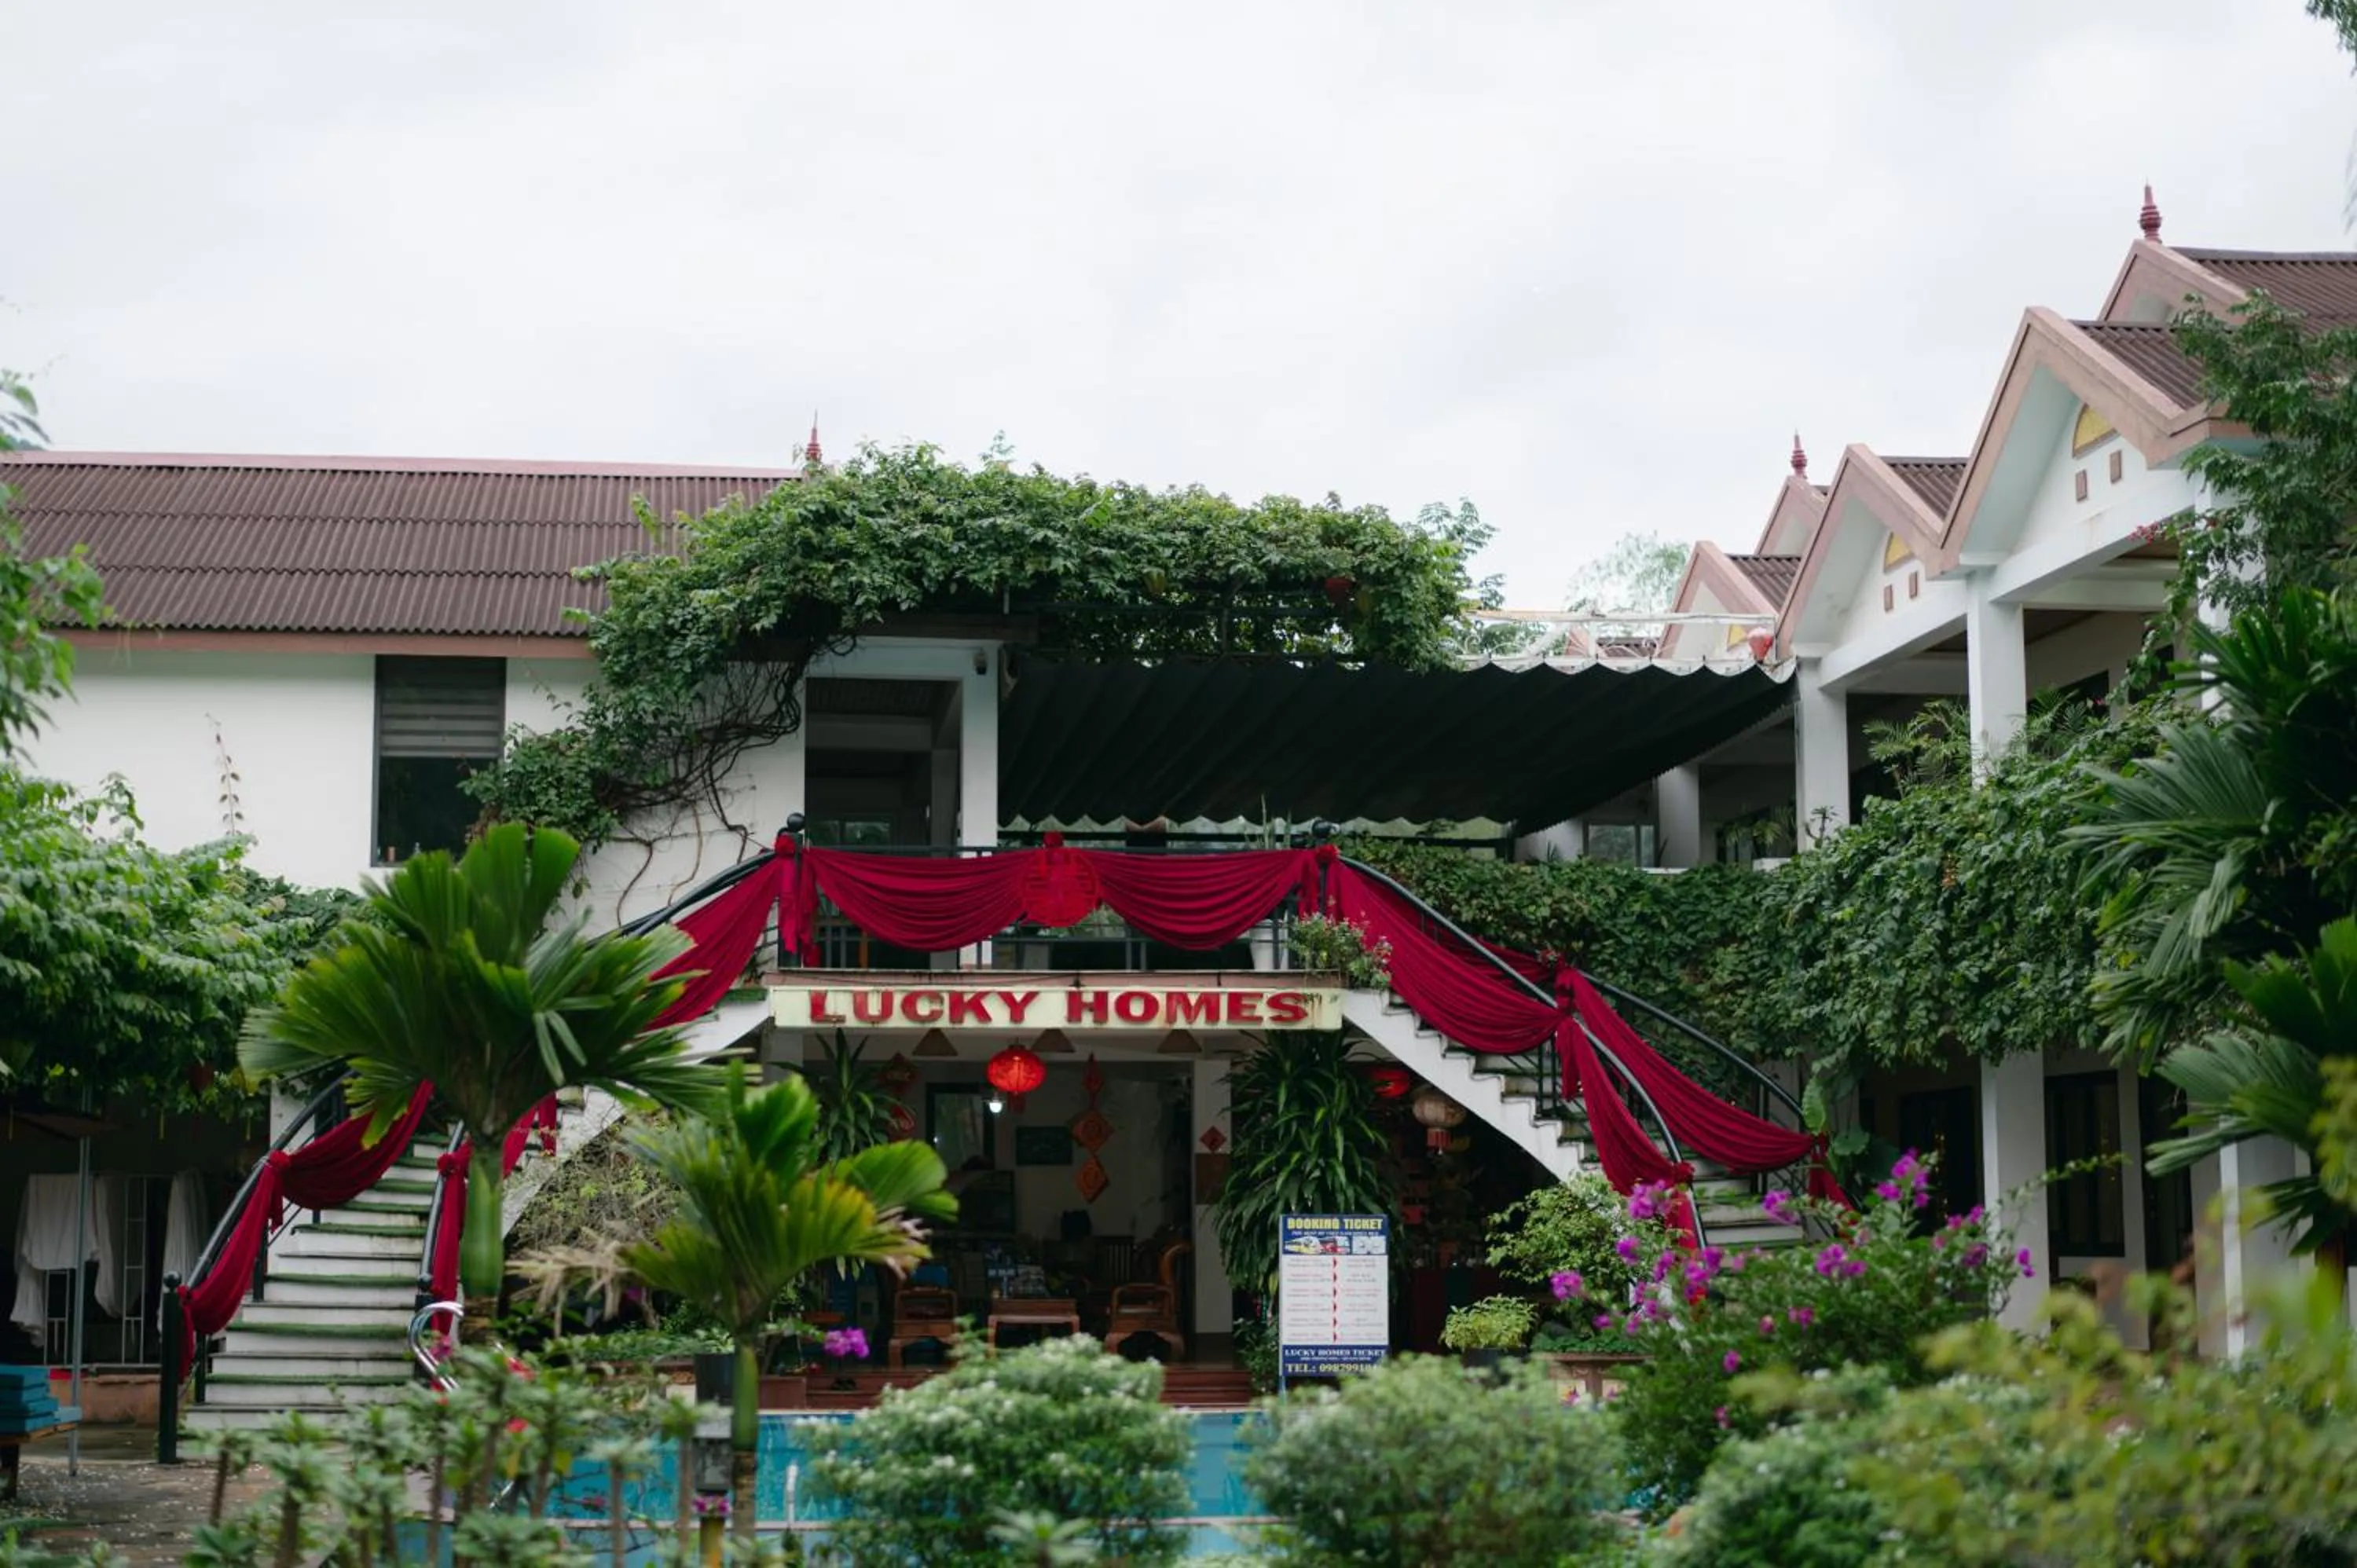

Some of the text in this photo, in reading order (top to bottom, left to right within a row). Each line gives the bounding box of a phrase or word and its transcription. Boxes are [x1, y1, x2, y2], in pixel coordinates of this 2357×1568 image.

[810, 990, 1308, 1025] LUCKY HOMES
[1287, 1218, 1383, 1230] BOOKING TICKET
[1286, 1363, 1317, 1373] TEL:
